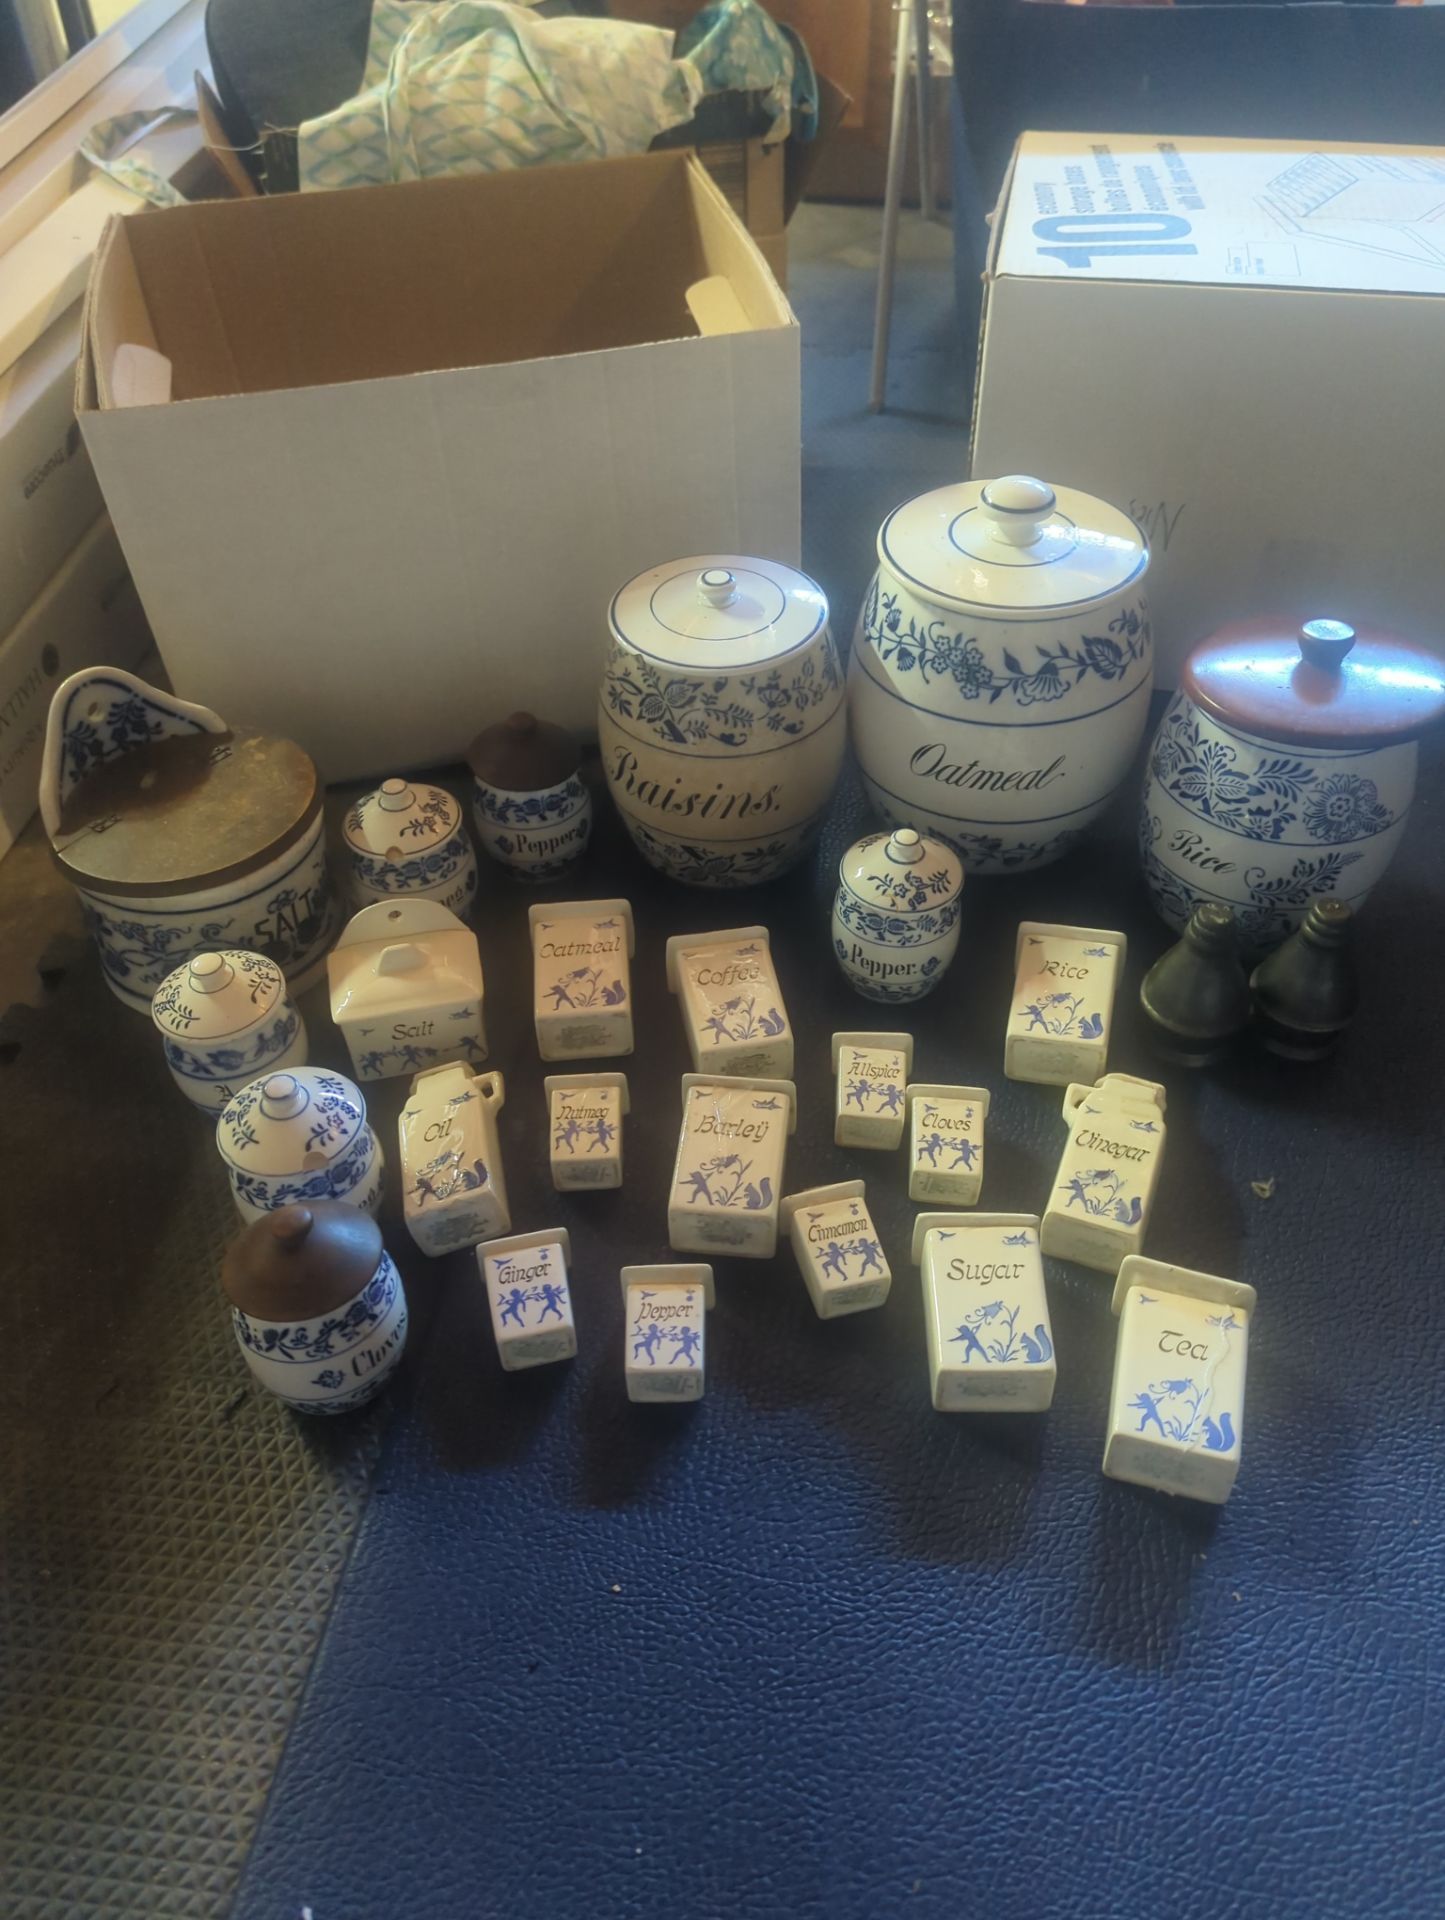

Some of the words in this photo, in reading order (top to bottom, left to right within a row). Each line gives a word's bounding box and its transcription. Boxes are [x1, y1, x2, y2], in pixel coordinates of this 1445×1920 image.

[1032, 213, 1198, 268] 10
[1167, 829, 1238, 875] Rice
[540, 936, 621, 959] Oatmeal
[698, 965, 760, 986] Coffee
[1037, 960, 1089, 980] Rice
[391, 1020, 435, 1041] Salt
[848, 1061, 900, 1080] Allspice
[555, 1105, 610, 1120] Nutmeg
[922, 1113, 972, 1131] Cloves
[423, 1117, 453, 1143] Oil
[1075, 1130, 1151, 1162] Vinegar
[808, 1218, 868, 1243] Cinnamon
[498, 1263, 552, 1284] Ginger
[946, 1258, 1025, 1286] Sugar
[634, 1302, 694, 1324] Pepper
[1158, 1329, 1209, 1361] Tea
